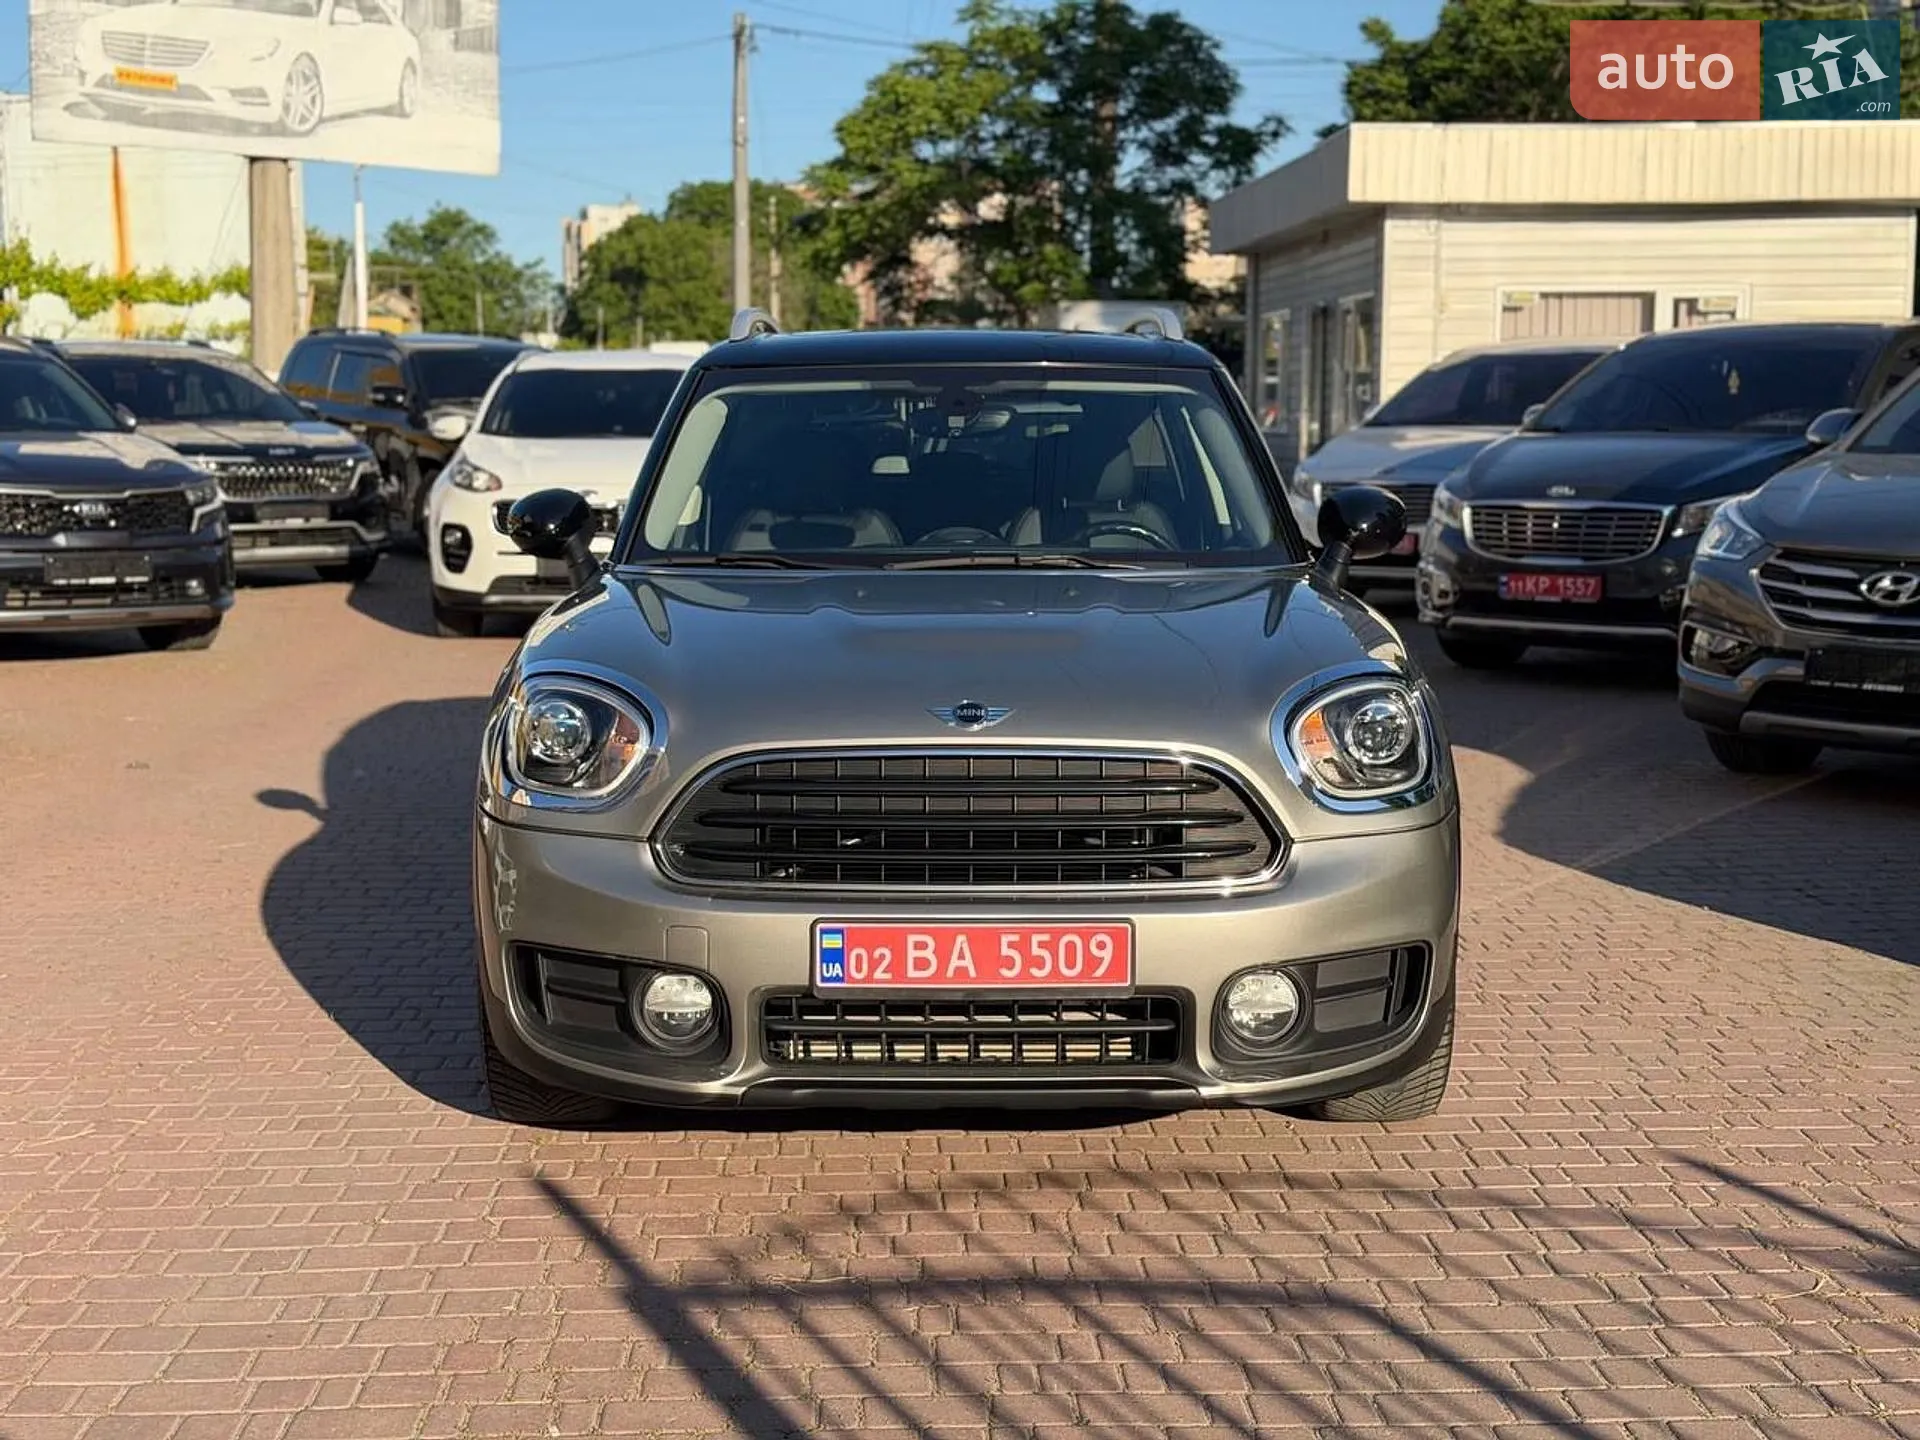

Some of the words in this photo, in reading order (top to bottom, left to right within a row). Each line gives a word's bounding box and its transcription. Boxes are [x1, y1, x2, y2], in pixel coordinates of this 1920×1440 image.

[1556, 577, 1596, 596] 1557
[956, 708, 985, 717] MINI
[850, 947, 892, 979] 02
[906, 934, 977, 979] BA
[999, 933, 1114, 979] 5509
[822, 962, 843, 978] UA
